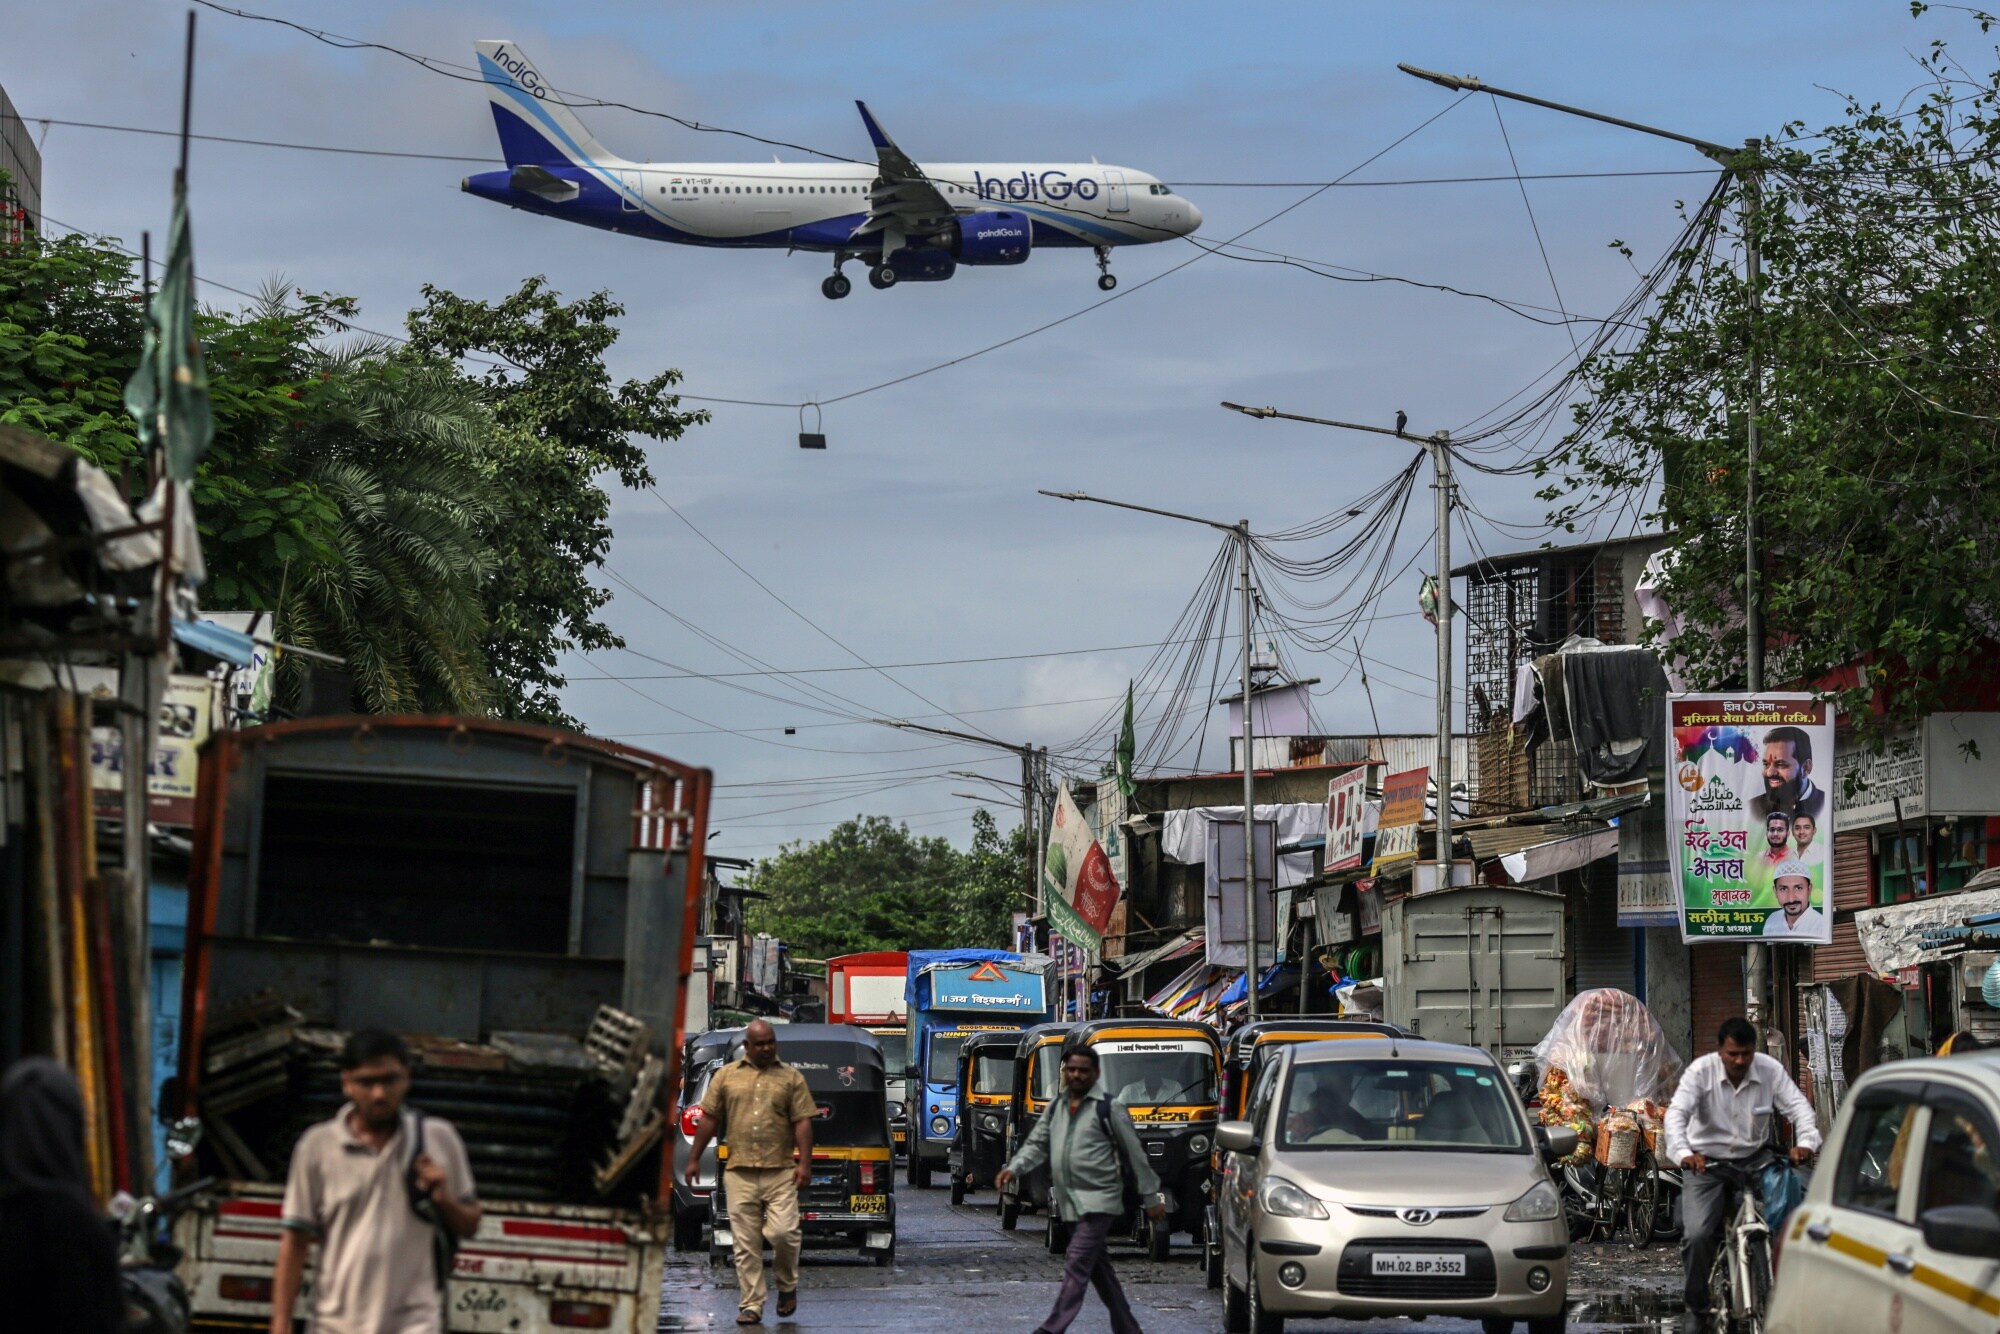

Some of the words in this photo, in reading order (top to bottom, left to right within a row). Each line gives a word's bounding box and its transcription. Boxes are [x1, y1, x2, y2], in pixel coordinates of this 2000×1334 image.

[493, 45, 545, 99] IndiGo
[974, 171, 1099, 200] IndiGo
[977, 228, 1022, 240] goIndiGo.in
[1723, 701, 1740, 712] शिव
[1756, 700, 1774, 711] सेना
[1682, 712, 1719, 726] मुस्लिम
[1722, 711, 1744, 723] सेवा
[1746, 711, 1781, 723] समिती
[1712, 889, 1751, 906] मुबारक
[1688, 909, 1730, 923] सलीम
[1733, 911, 1765, 923] भाऊ
[1727, 925, 1752, 934] अध्यक्ष
[971, 993, 1023, 1006] विश्वकर्मा
[1376, 1260, 1461, 1273] MH.02.BP.3552
